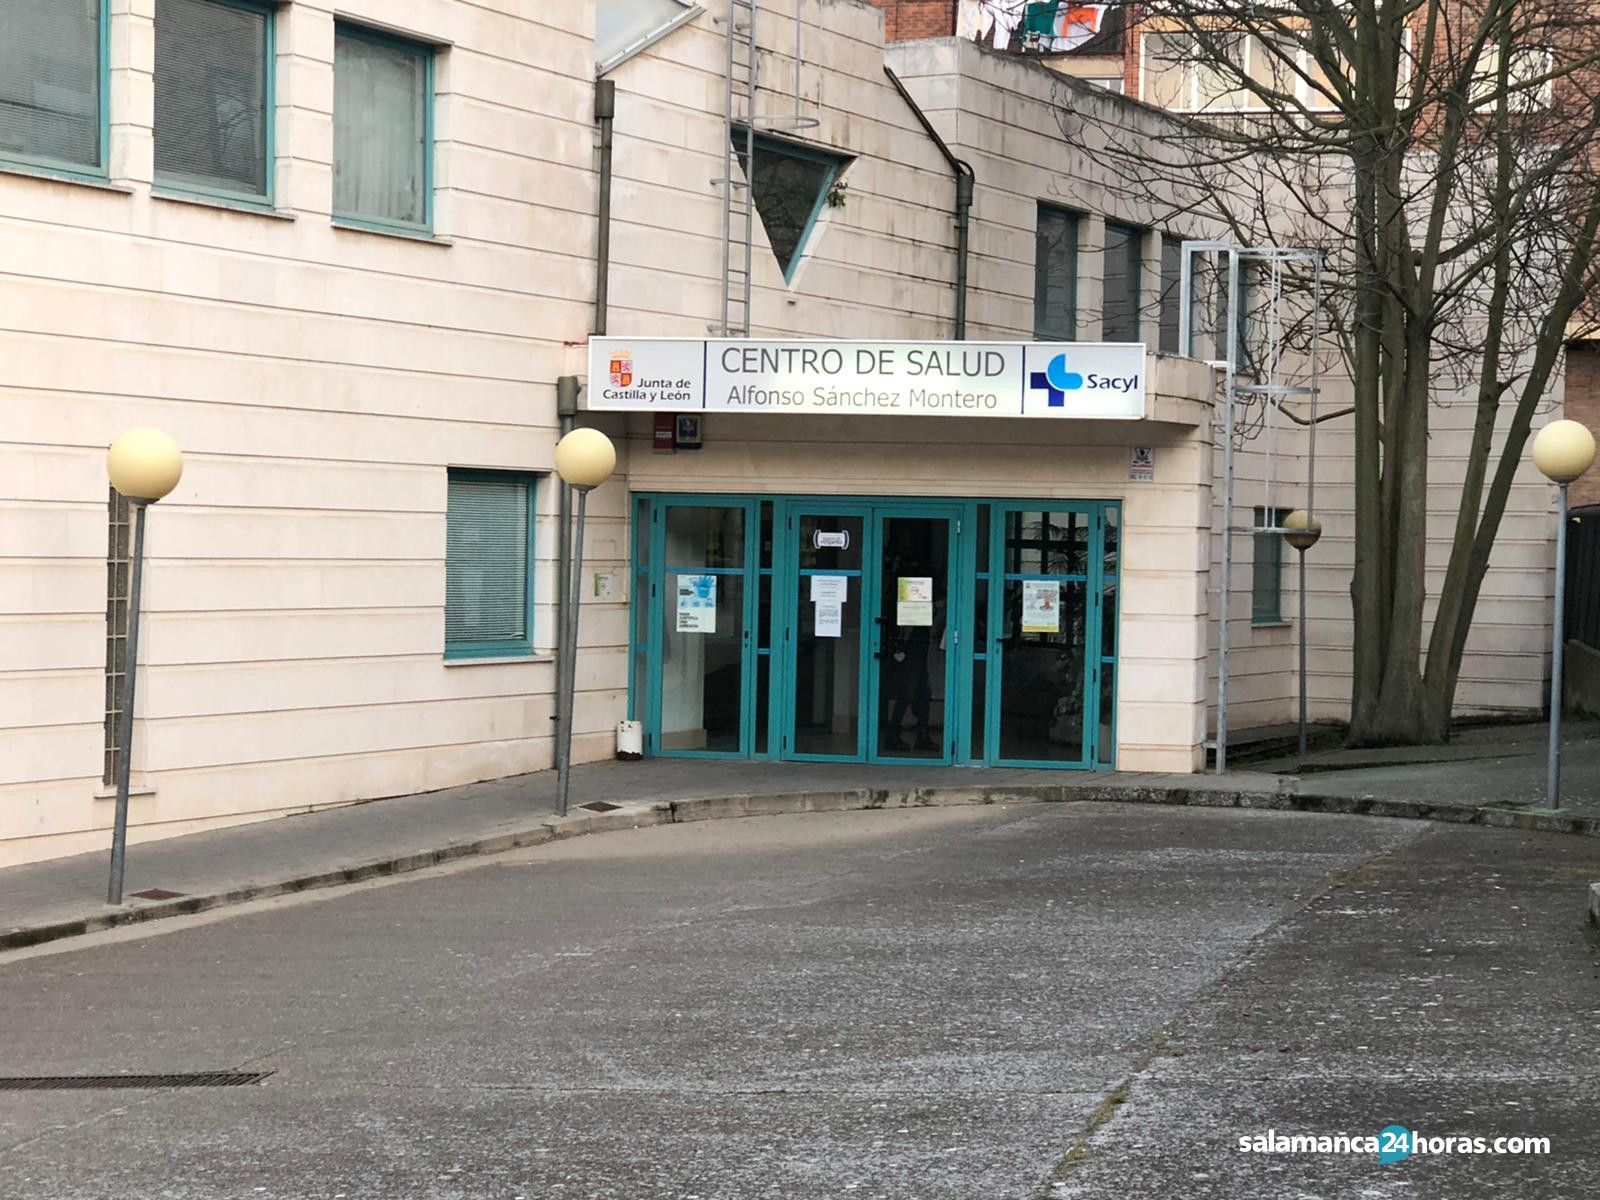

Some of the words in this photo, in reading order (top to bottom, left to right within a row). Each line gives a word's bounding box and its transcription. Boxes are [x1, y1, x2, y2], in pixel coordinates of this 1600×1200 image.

[721, 347, 843, 375] CENTRO
[856, 349, 895, 375] DE
[906, 349, 1005, 377] SALUD
[637, 377, 672, 389] Junta
[675, 378, 691, 389] de
[1087, 374, 1138, 393] Sacyl
[602, 388, 647, 401] Castilla
[648, 391, 657, 402] y
[660, 389, 691, 401] León
[726, 385, 804, 406] Alfonso
[813, 386, 900, 408] Sánchez
[909, 389, 997, 409] Montero
